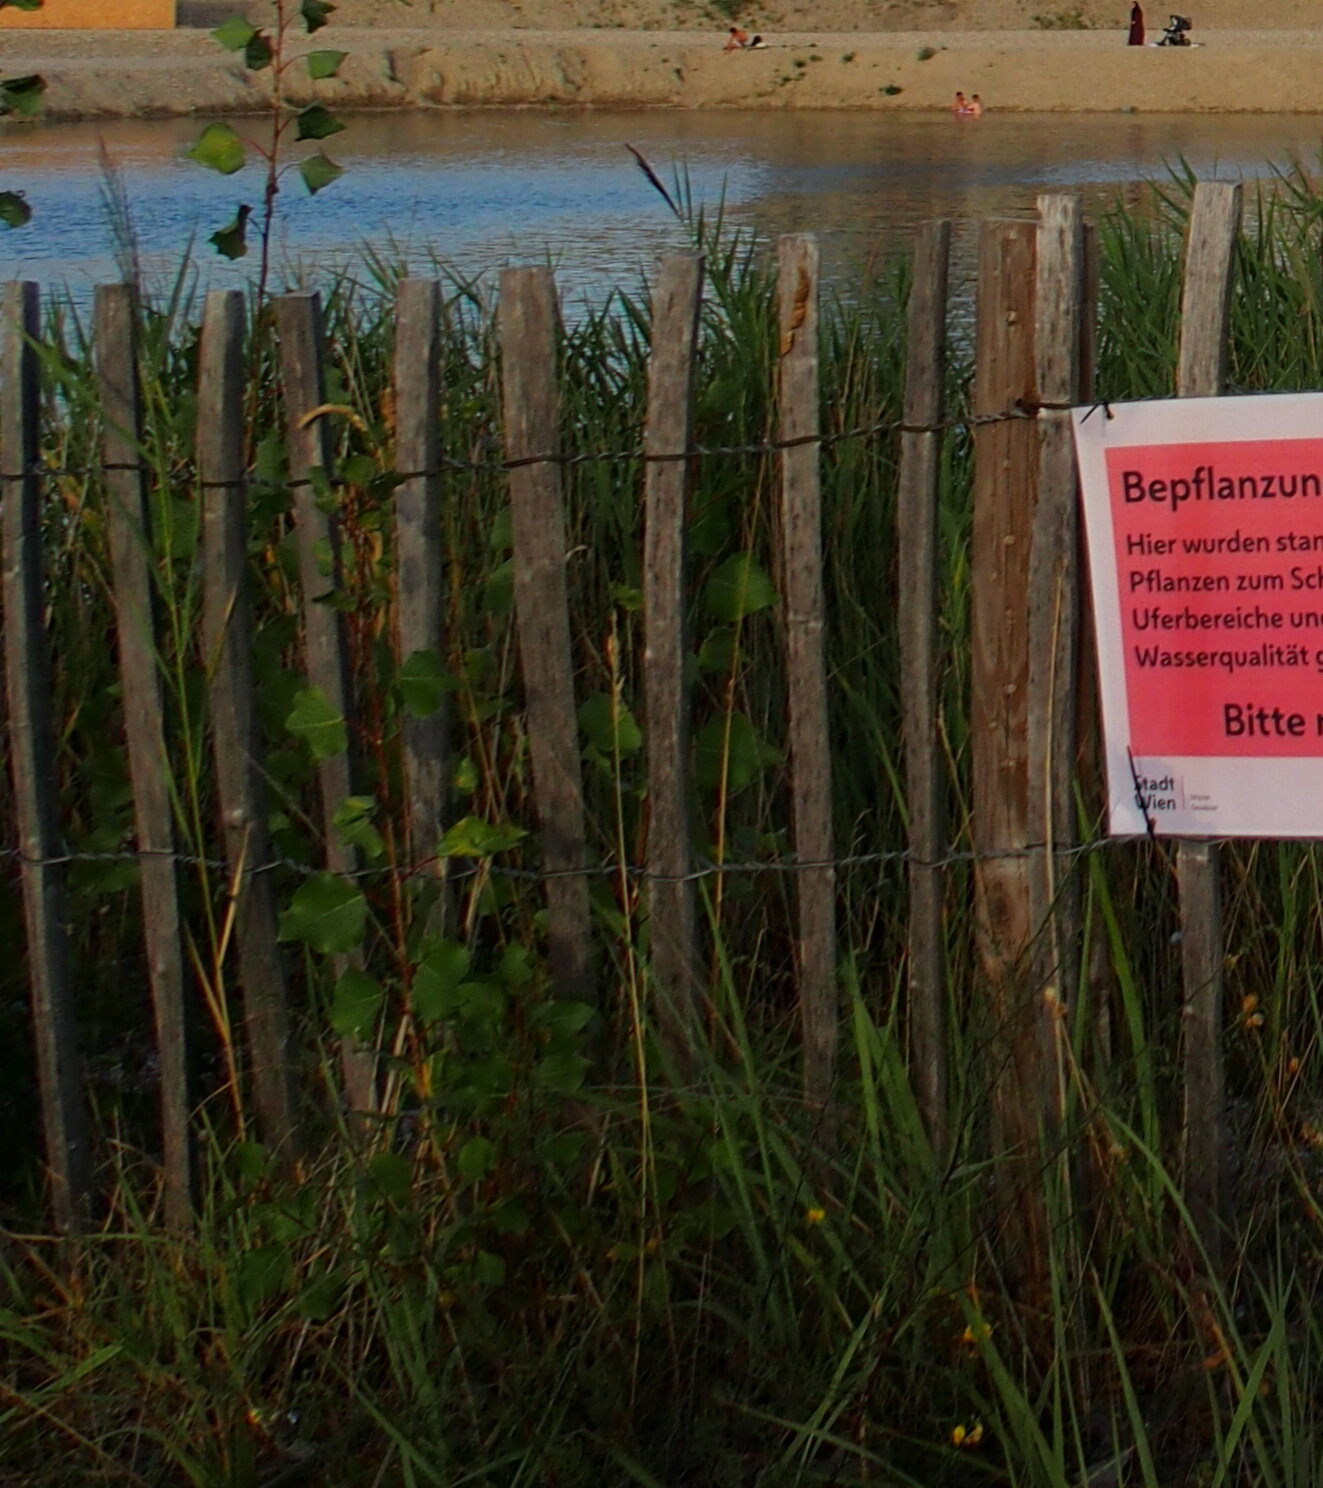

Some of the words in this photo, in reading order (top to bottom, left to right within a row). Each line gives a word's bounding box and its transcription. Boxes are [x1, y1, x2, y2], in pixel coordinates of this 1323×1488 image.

[1127, 533, 1176, 556] Hier
[1183, 530, 1270, 554] wurden
[1130, 570, 1230, 593] Pflanzen
[1236, 574, 1284, 591] zum
[1132, 605, 1284, 631] Uferbereiche
[1134, 643, 1309, 672] Wasserqualität
[1223, 703, 1306, 737] Bitte
[1134, 794, 1176, 810] Wien
